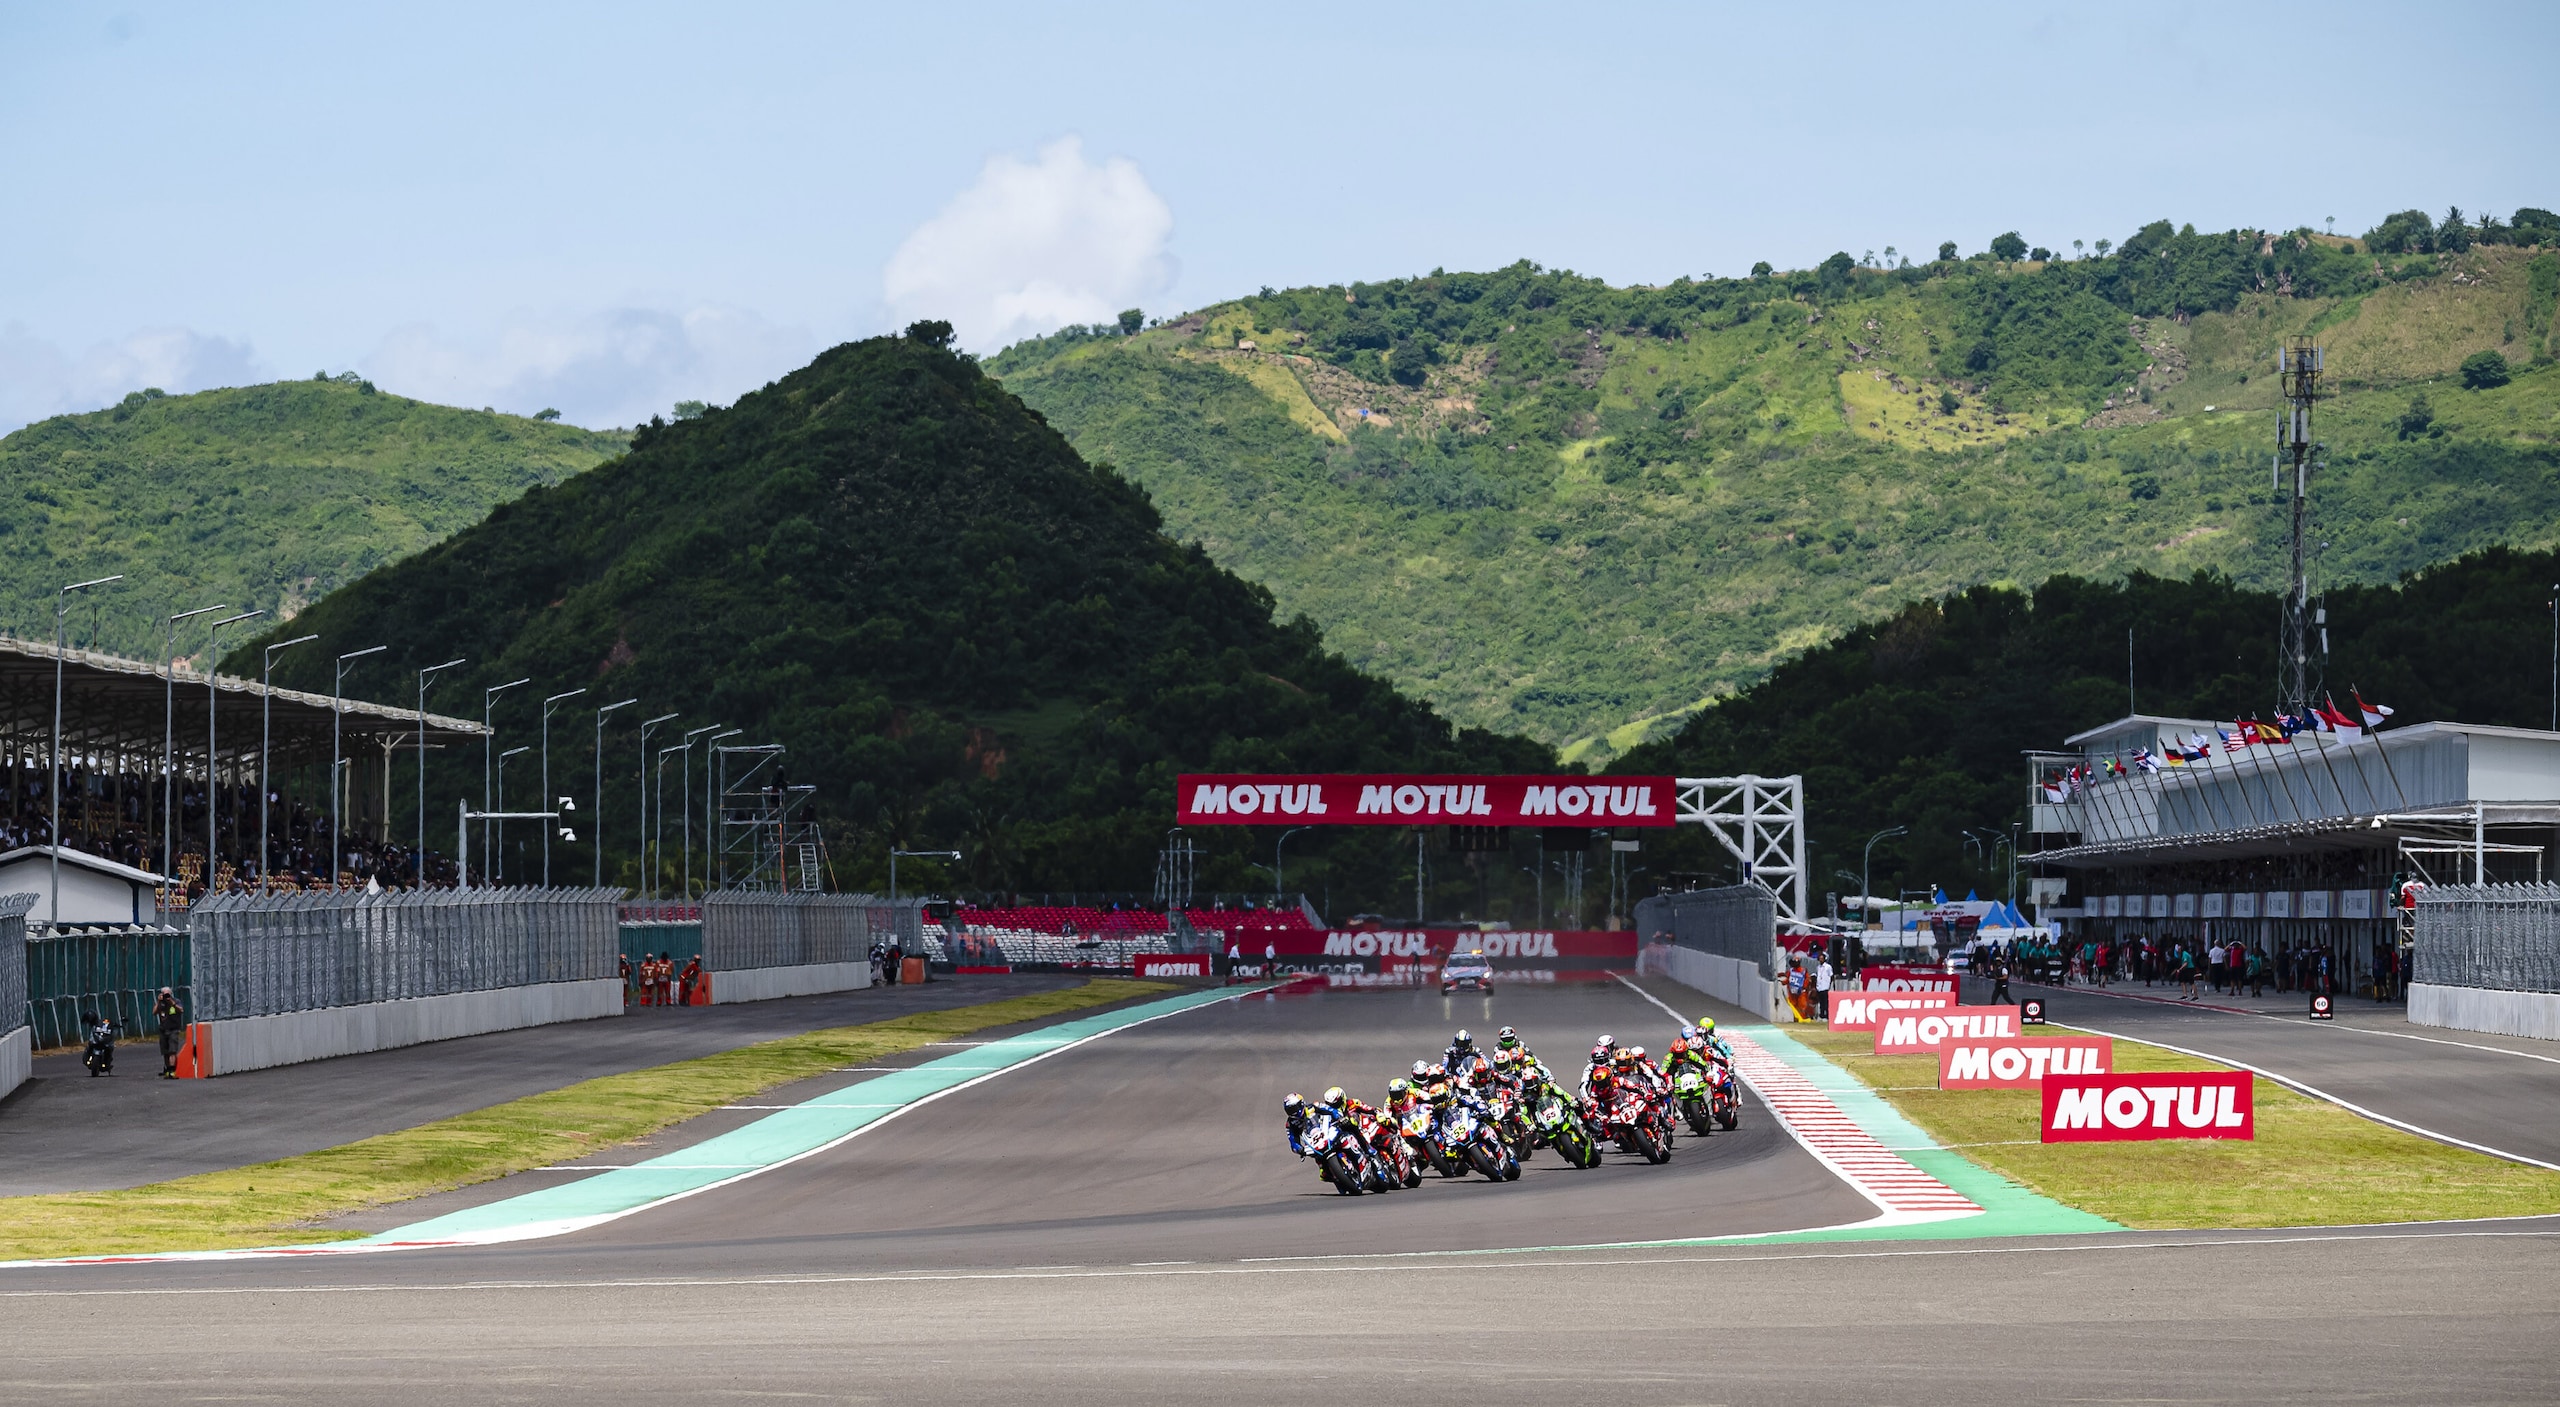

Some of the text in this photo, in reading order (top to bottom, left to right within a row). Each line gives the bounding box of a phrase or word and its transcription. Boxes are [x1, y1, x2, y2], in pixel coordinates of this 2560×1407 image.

[1190, 784, 1657, 816] MOTUL MOTUL MOTUL
[1323, 932, 1558, 957] MOTUL MOTUL
[1881, 1015, 2016, 1045] MOTUL
[1947, 1047, 2106, 1080] MOTUL
[2051, 1086, 2245, 1129] MOTUL
[1312, 1132, 1325, 1146] 54
[1453, 1124, 1466, 1138] 55
